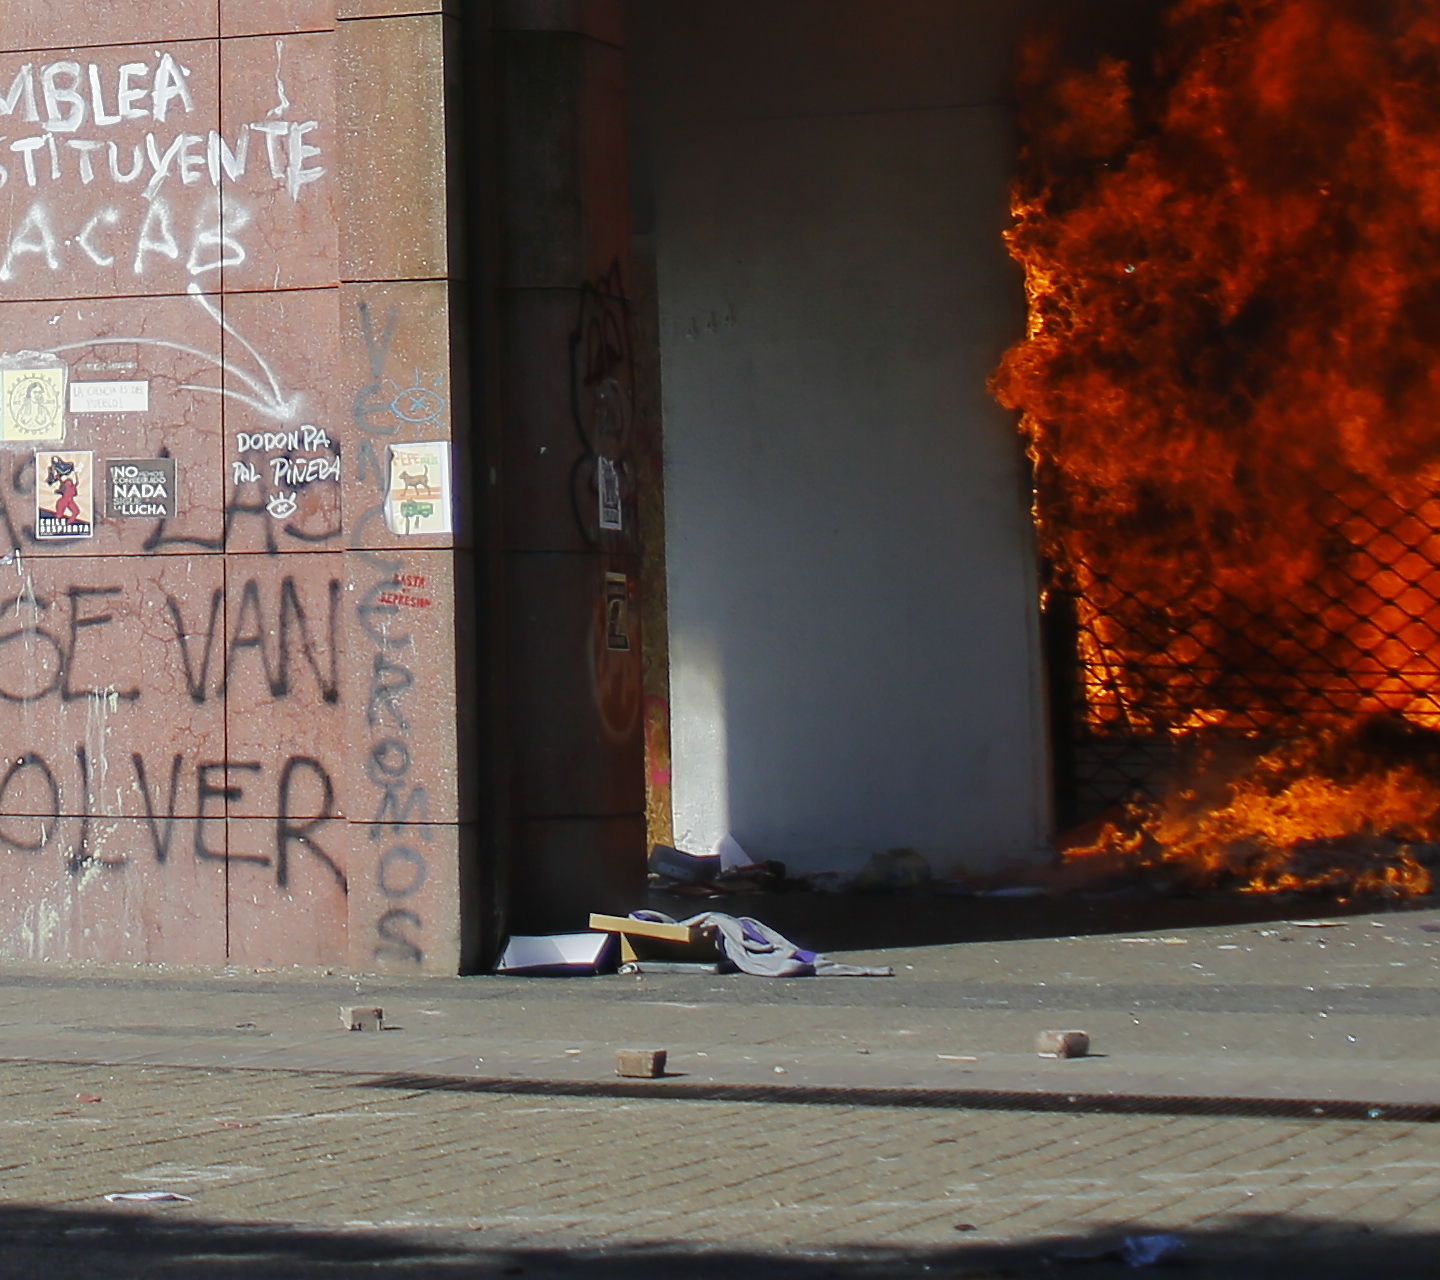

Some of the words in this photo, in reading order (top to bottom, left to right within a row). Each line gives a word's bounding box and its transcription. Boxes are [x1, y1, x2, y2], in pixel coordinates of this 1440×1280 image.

[232, 461, 262, 486] PAL
[114, 484, 168, 498] NADA
[122, 504, 167, 516] LUCHA
[39, 518, 67, 526] CHILE
[164, 575, 343, 708] VAN
